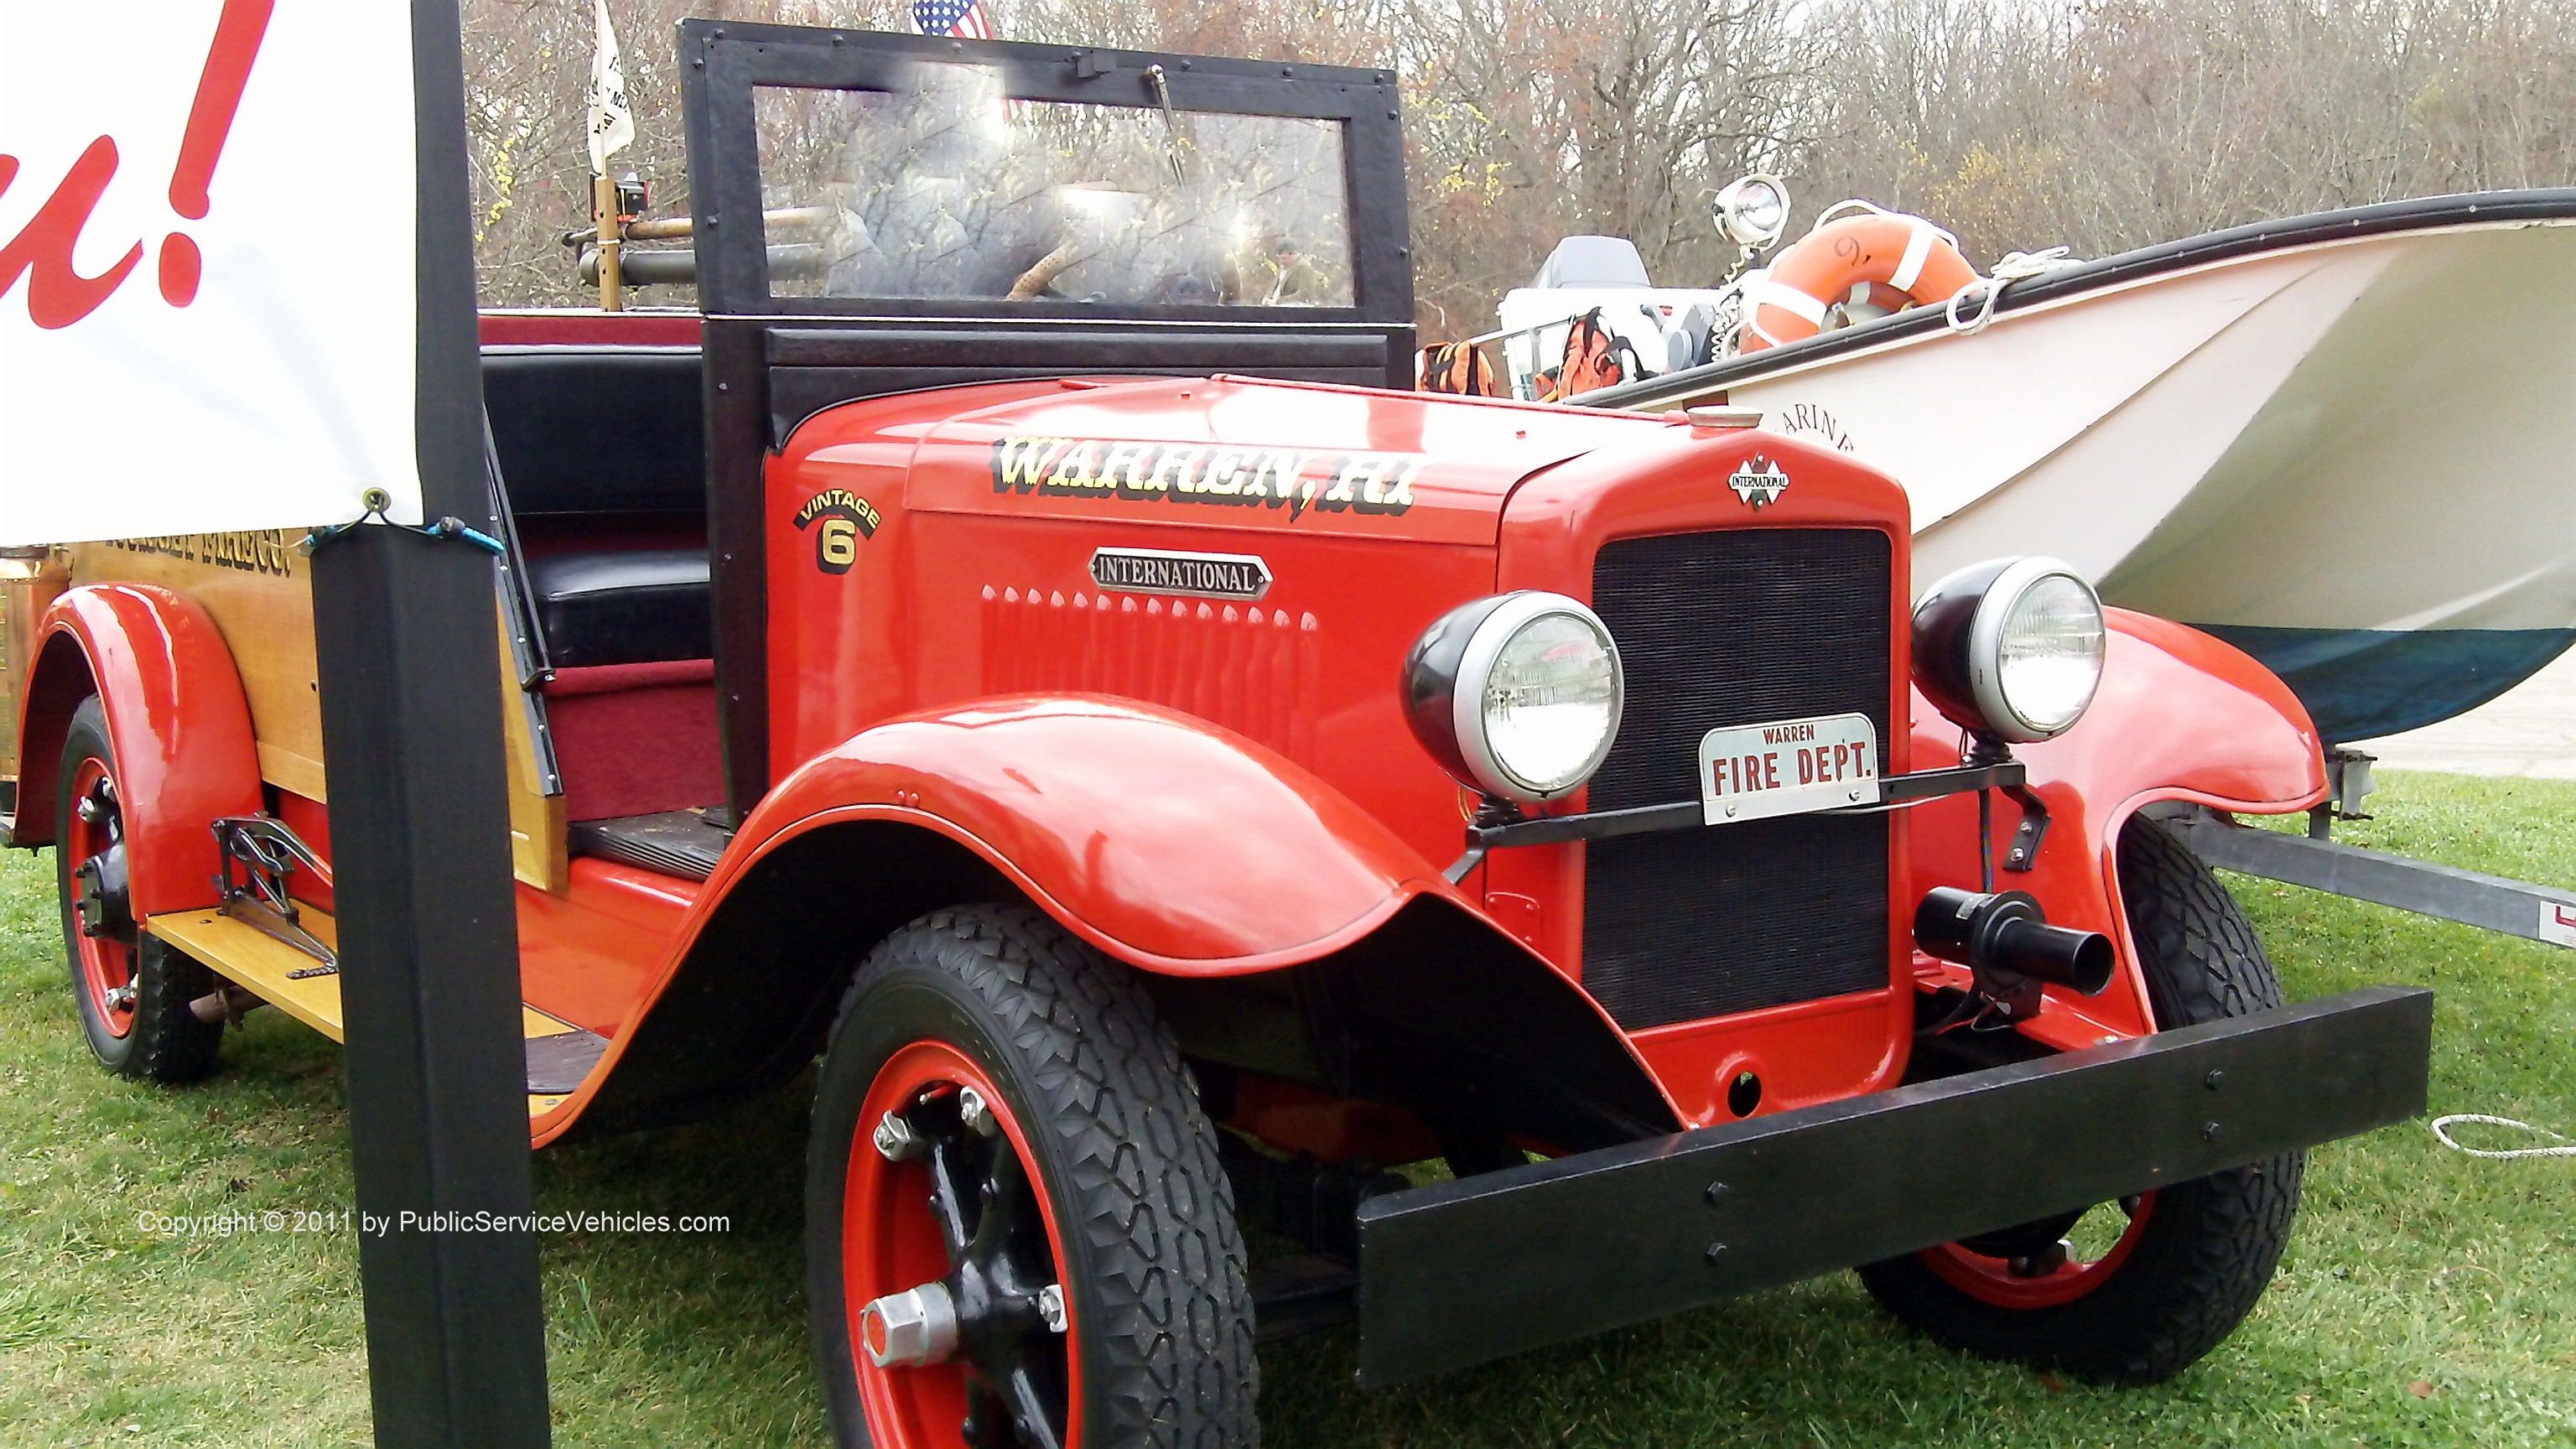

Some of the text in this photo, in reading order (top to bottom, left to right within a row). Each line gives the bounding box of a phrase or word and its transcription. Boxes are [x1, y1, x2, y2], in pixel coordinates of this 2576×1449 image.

[1322, 455, 1415, 512] RI
[1732, 475, 1786, 488] INTERNATIONAL
[799, 489, 881, 530] VINTAGE
[820, 518, 856, 569] 6
[1098, 555, 1256, 591] INTERNATIONAL
[1763, 724, 1815, 745] WARREN
[1712, 752, 1780, 796] FIRE
